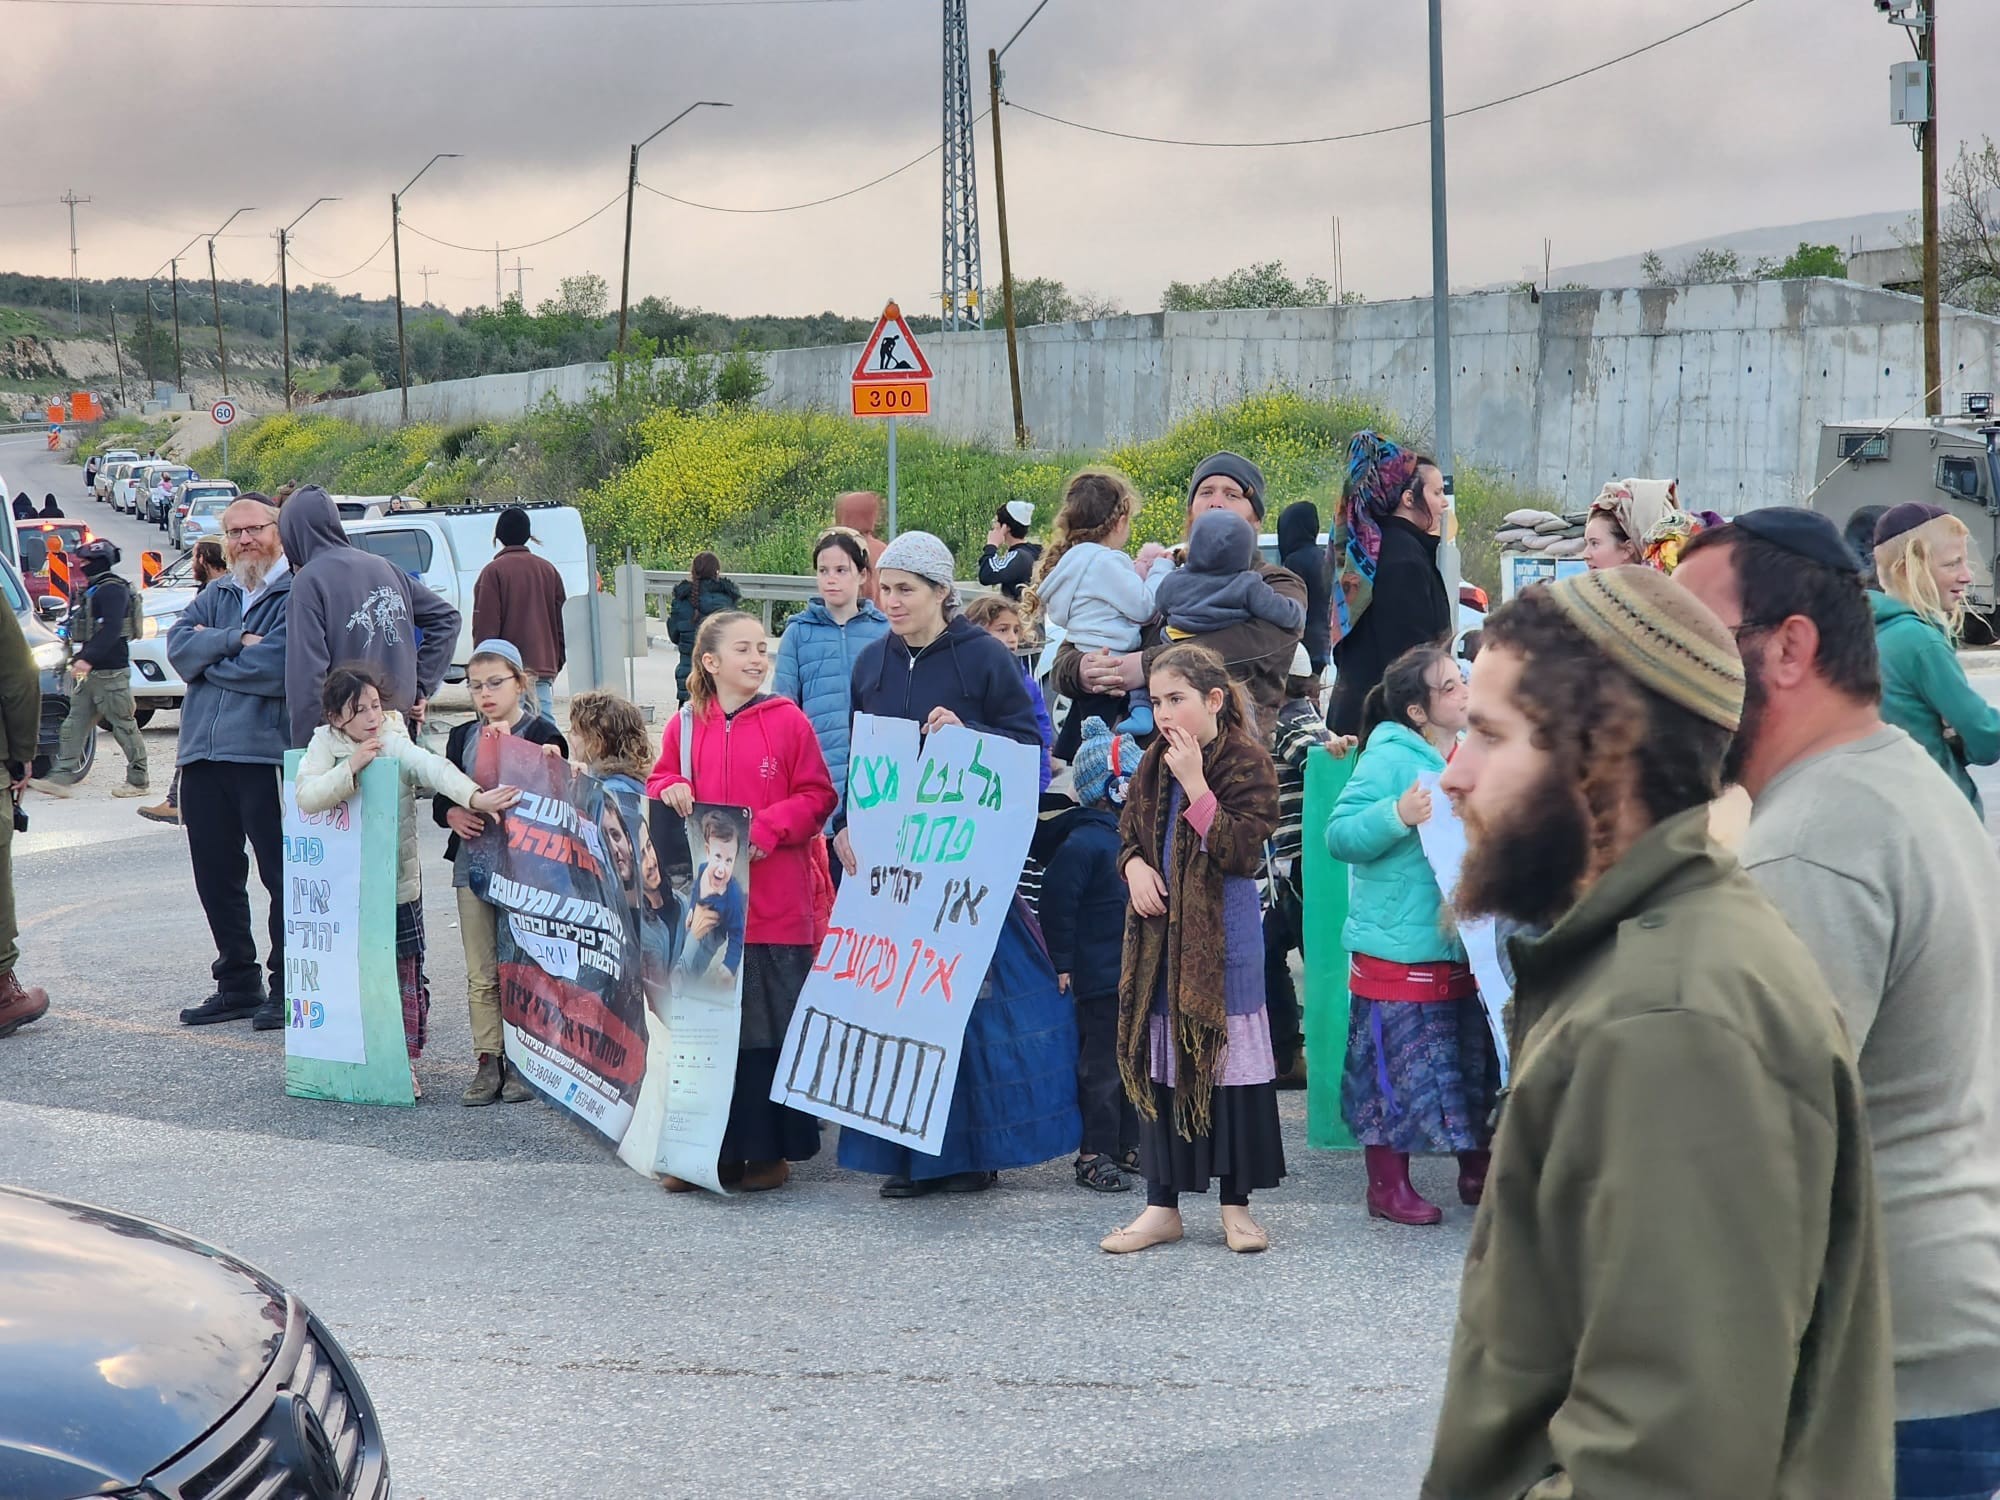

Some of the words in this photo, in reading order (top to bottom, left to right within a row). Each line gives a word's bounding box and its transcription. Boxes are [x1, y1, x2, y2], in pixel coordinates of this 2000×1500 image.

[216, 408, 231, 418] 60
[869, 389, 912, 408] 300
[917, 738, 1002, 811] גלנט
[292, 876, 331, 914] אין
[870, 864, 923, 906] יהודים
[933, 877, 989, 933] אין
[286, 957, 320, 994] אין
[896, 938, 962, 1008] אין
